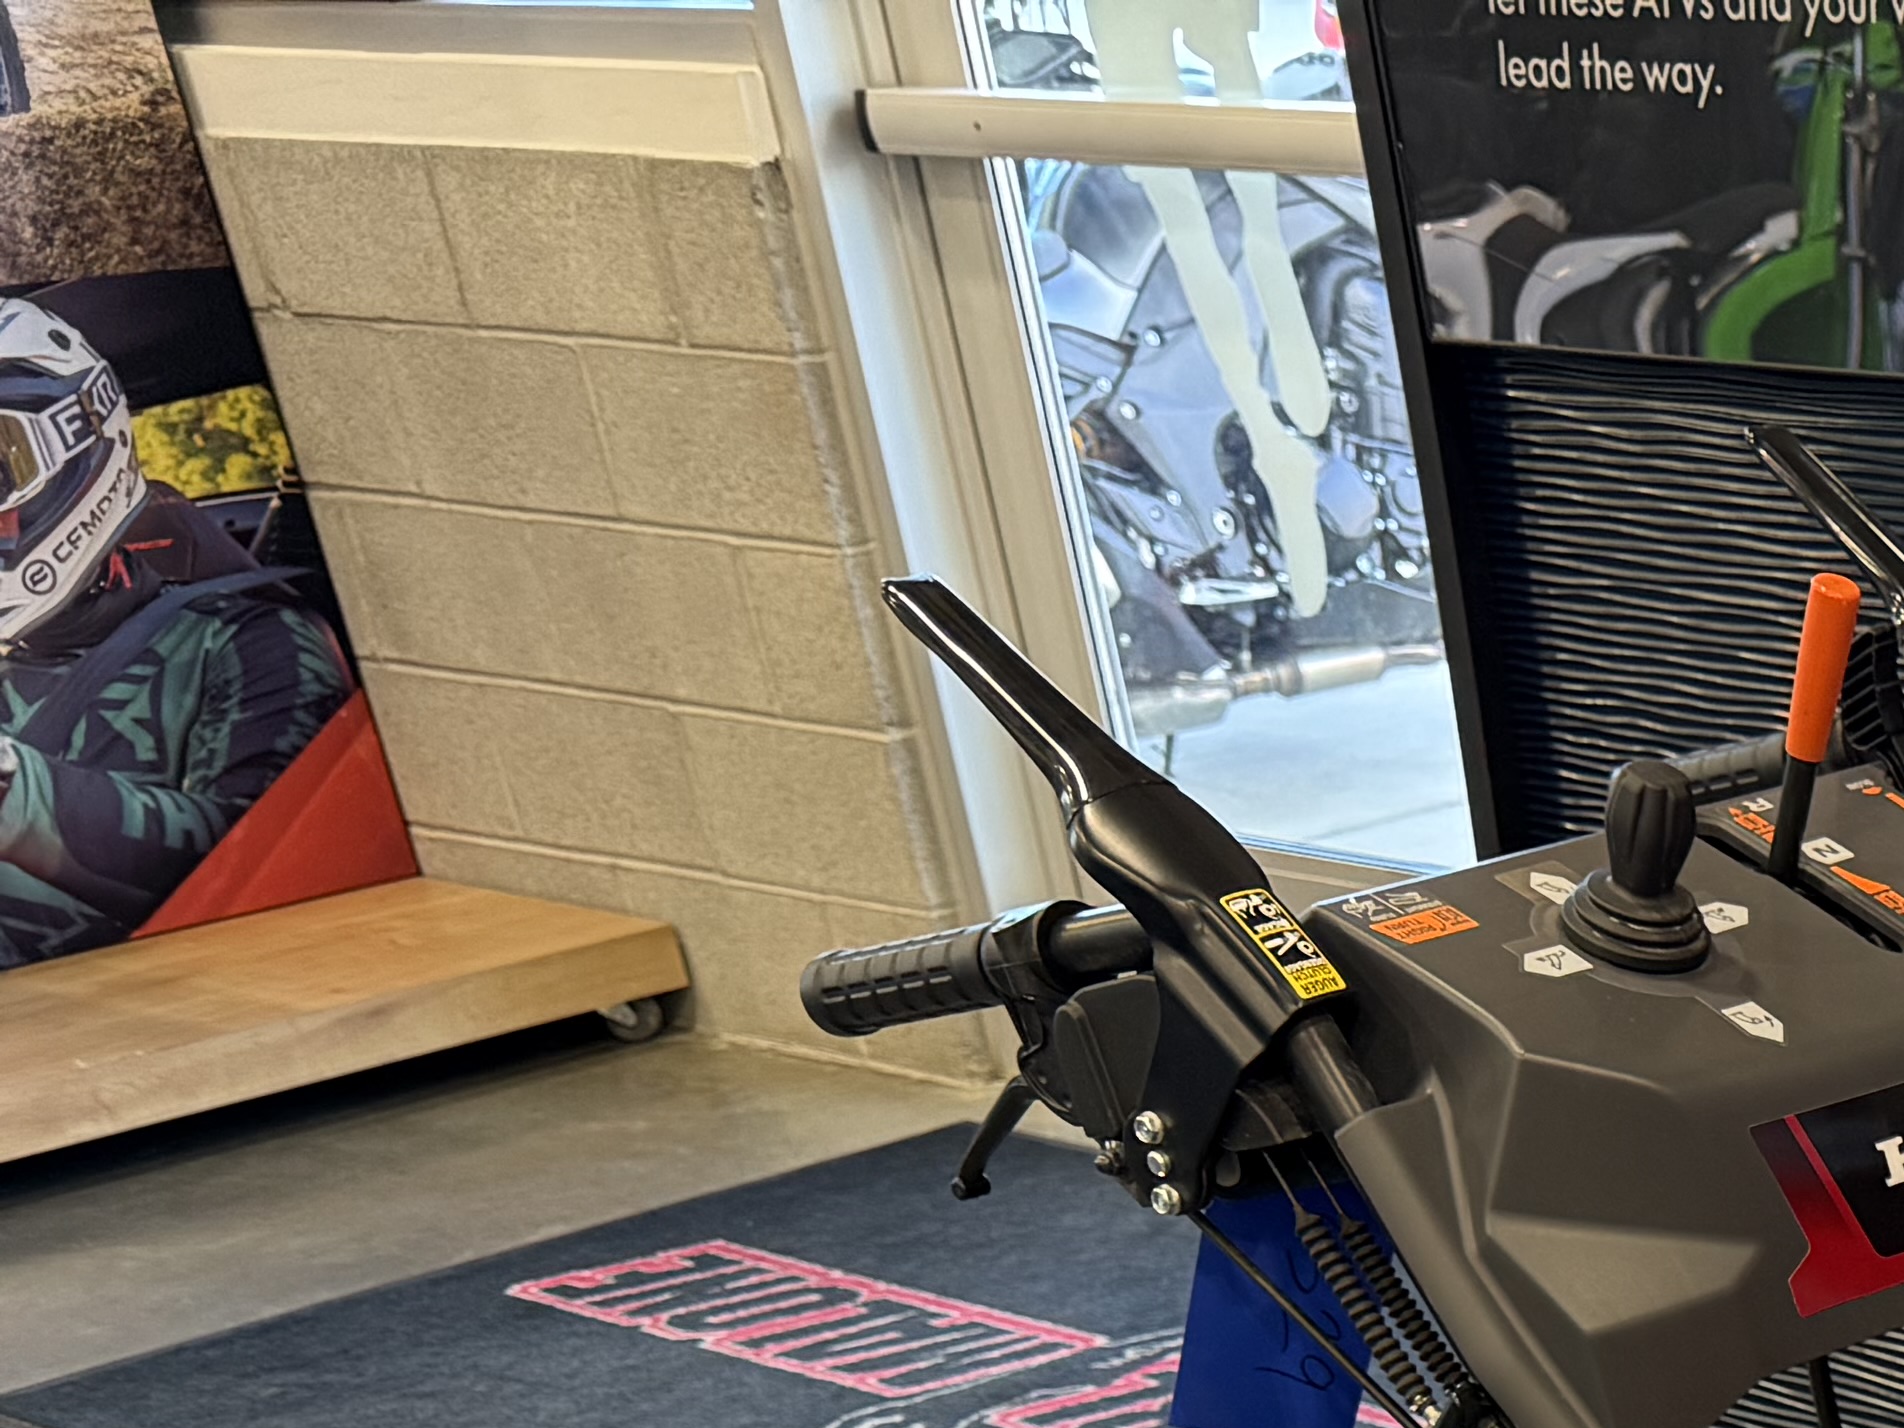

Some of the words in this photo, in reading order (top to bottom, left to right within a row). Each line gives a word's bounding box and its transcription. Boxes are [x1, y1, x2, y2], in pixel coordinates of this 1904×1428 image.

[1497, 39, 1571, 90] lead
[1580, 41, 1634, 91] the
[1640, 61, 1723, 109] way.
[1299, 974, 1340, 996] AUGER
